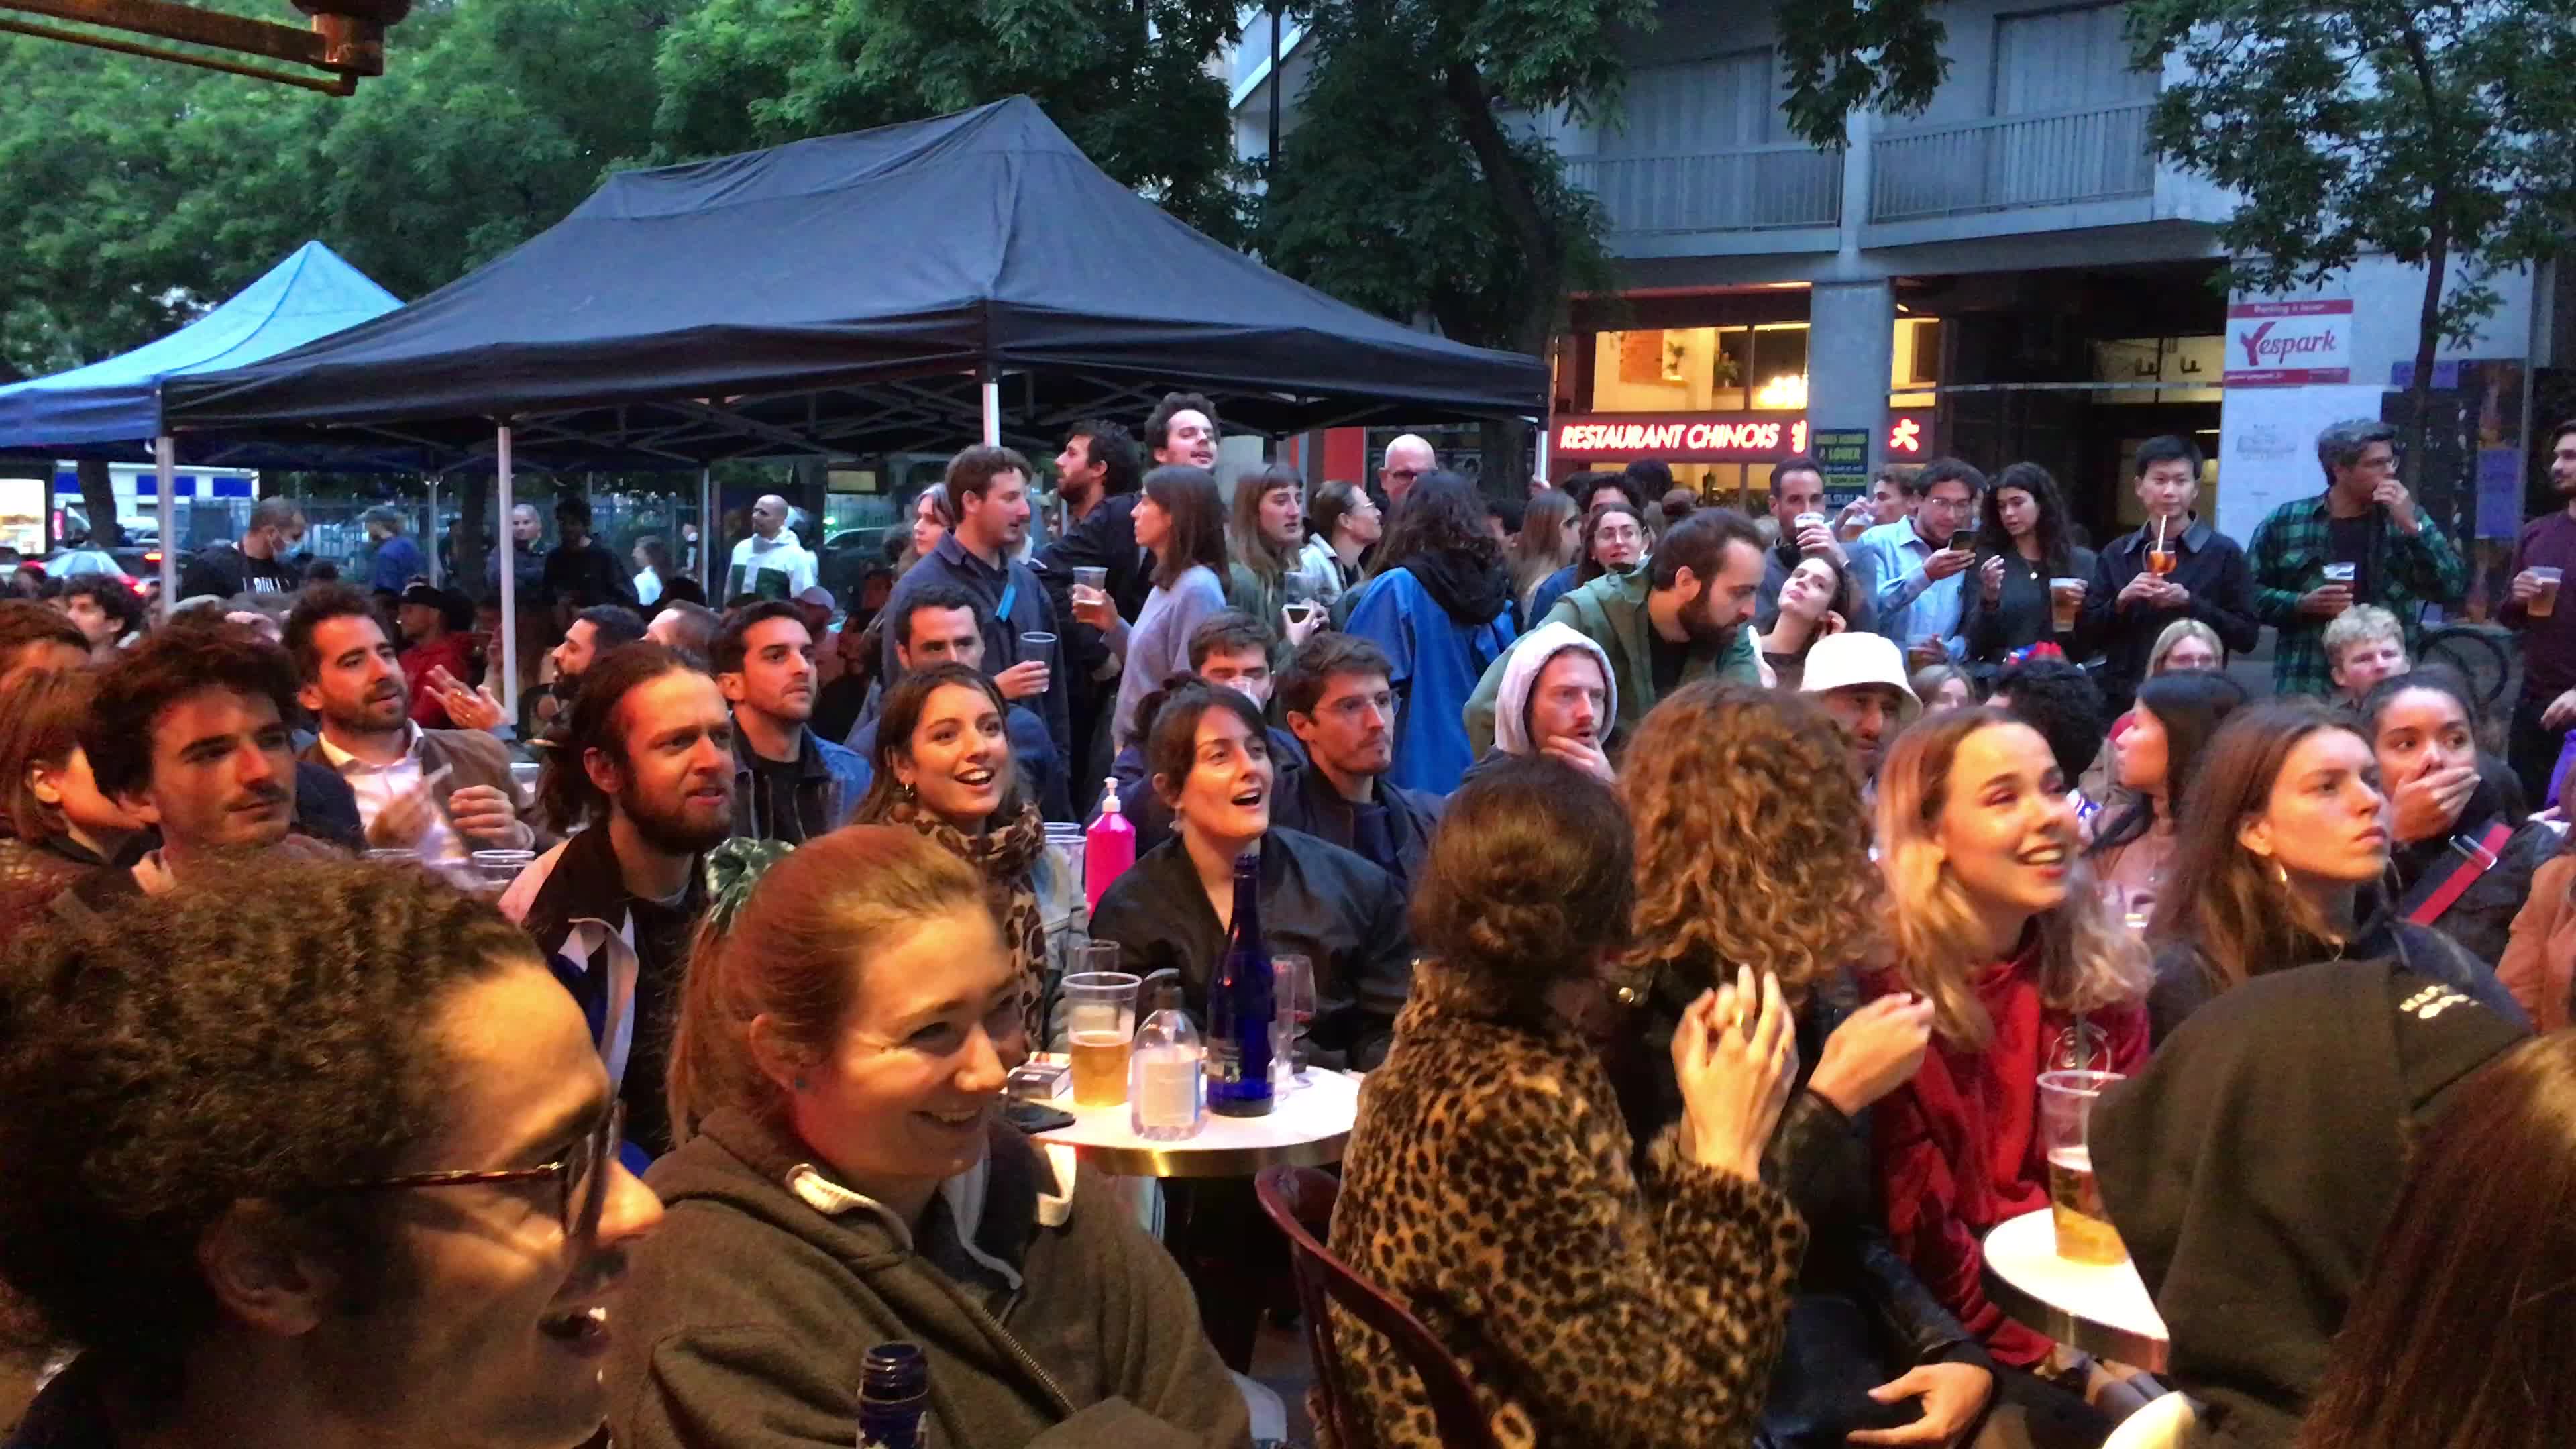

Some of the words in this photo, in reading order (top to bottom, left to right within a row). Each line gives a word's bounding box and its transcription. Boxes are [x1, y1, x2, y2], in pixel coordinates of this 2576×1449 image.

[2239, 321, 2336, 366] Yespark
[1559, 424, 1687, 449] RESTAURANT
[1687, 423, 1781, 449] CHINOIS
